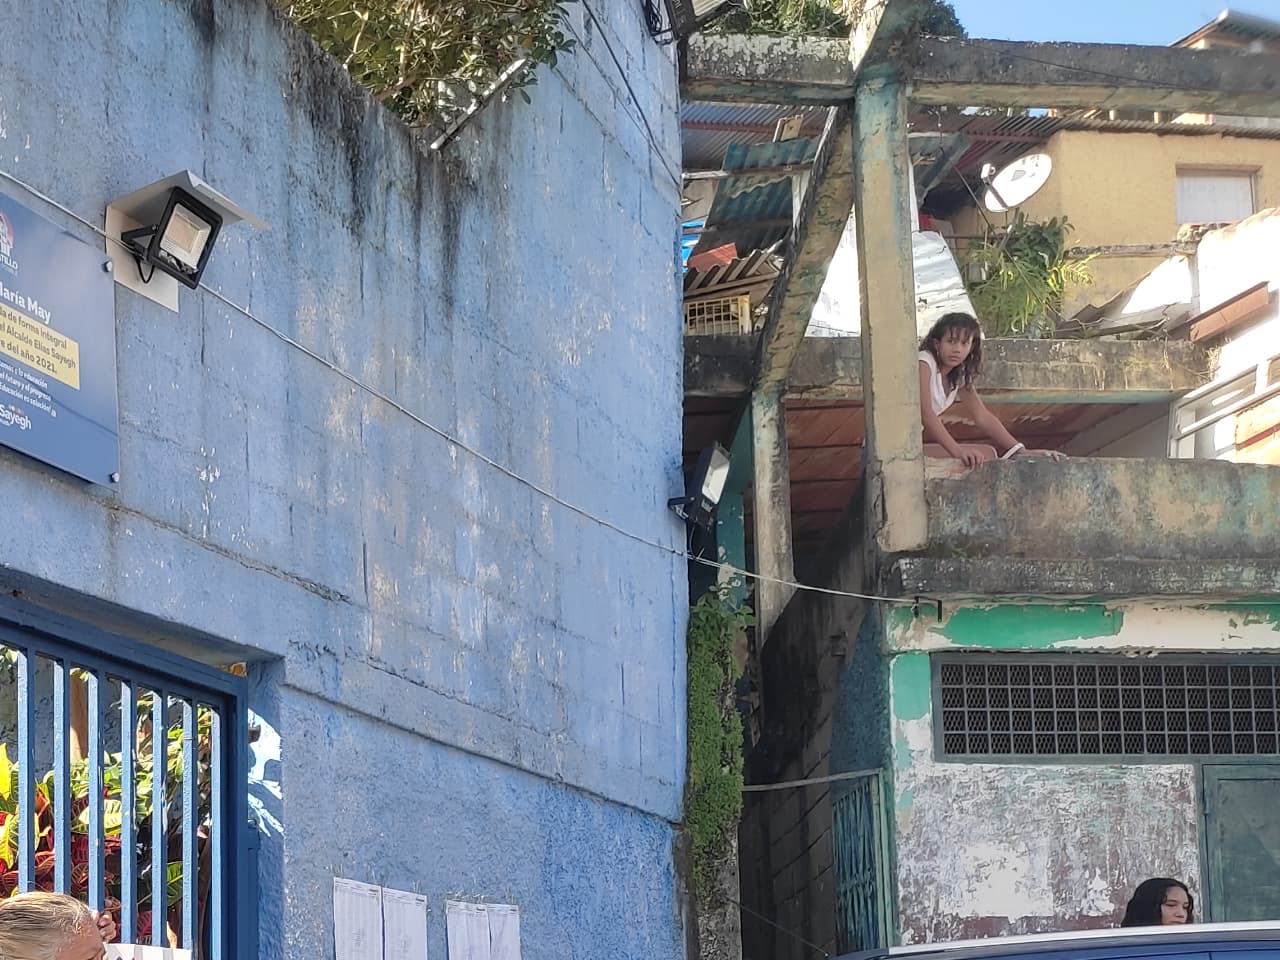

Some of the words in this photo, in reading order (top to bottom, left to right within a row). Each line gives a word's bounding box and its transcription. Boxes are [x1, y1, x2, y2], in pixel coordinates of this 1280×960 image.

[27, 296, 51, 324] May
[7, 312, 18, 324] de
[18, 315, 40, 335] forma
[6, 325, 33, 347] Alcalde
[51, 349, 76, 369] Sayegh
[6, 339, 20, 355] del
[20, 348, 35, 363] año
